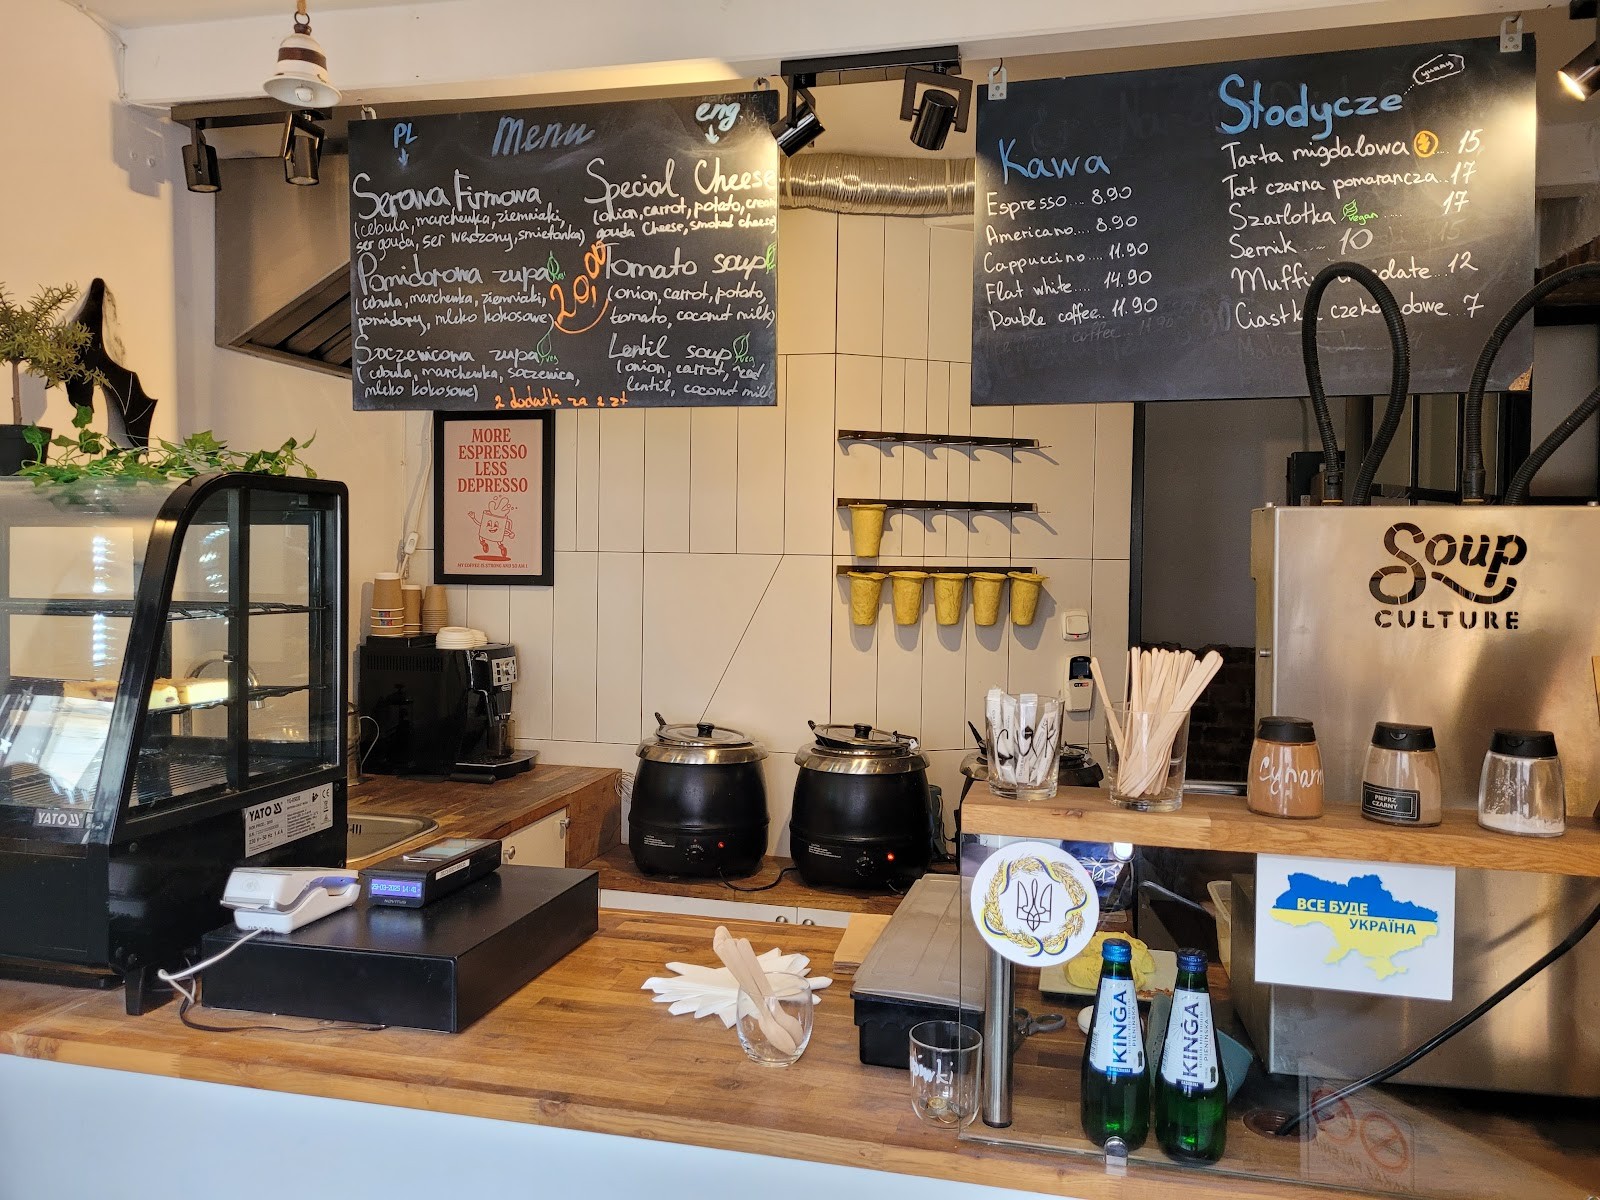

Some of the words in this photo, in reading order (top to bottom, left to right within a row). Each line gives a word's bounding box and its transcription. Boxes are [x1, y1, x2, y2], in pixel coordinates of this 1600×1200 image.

[694, 102, 741, 131] eng
[393, 122, 417, 148] PL
[491, 116, 595, 157] Menu
[999, 138, 1111, 184] Kawa
[1221, 142, 1284, 170] Tarta
[353, 172, 451, 220] Serowa
[453, 168, 542, 212] Firmowa
[584, 157, 679, 213] Special
[694, 157, 777, 194] Cheese
[1221, 174, 1258, 200] Tort
[1265, 176, 1326, 196] czarna
[1450, 161, 1478, 185] 17
[986, 191, 1067, 220] Espresso
[1091, 186, 1132, 205] 8.90
[1228, 202, 1337, 231] Szarlotka
[1442, 190, 1469, 215] 17
[423, 235, 446, 249] ser
[986, 225, 1075, 246] Americano
[1095, 215, 1138, 232] 8.90
[1228, 231, 1298, 259] Sernik
[1339, 227, 1374, 256] 10
[596, 242, 698, 279] Tomato
[712, 252, 767, 280] soup
[984, 251, 1085, 275] Cappuccino
[1109, 242, 1149, 260] 11.90
[1447, 251, 1479, 274] 12
[357, 252, 483, 295] Pomidorowa
[492, 265, 553, 291] zupa
[986, 280, 1024, 305] Flat
[1033, 274, 1073, 297] white
[1104, 268, 1152, 289] 14.90
[435, 308, 477, 326] mleko
[676, 303, 733, 322] coconut
[988, 307, 1047, 331] Double
[1112, 296, 1158, 318] 11.90
[1235, 299, 1323, 330] Ciastk
[1330, 291, 1449, 320] czekodowe
[1463, 292, 1485, 319] 7
[489, 348, 540, 369] zupa
[608, 332, 670, 359] Lentil
[685, 344, 732, 365] soup
[364, 380, 405, 399] mleko
[567, 395, 588, 407] za
[472, 428, 511, 443] MORE
[458, 444, 527, 460] ESPRESSO
[475, 461, 507, 476] LESS
[457, 477, 528, 493] DEPRESSO
[1369, 522, 1528, 605] Soup
[1375, 609, 1520, 630] CULTURE
[1371, 800, 1398, 810] CZARNY
[1374, 794, 1397, 804] PIEPRZ
[37, 812, 67, 825] YATO
[249, 806, 271, 821] YATO
[1296, 897, 1326, 912] ВСЕ
[1329, 901, 1368, 917] БУДЕ
[1349, 918, 1417, 935] УКРАЇНА
